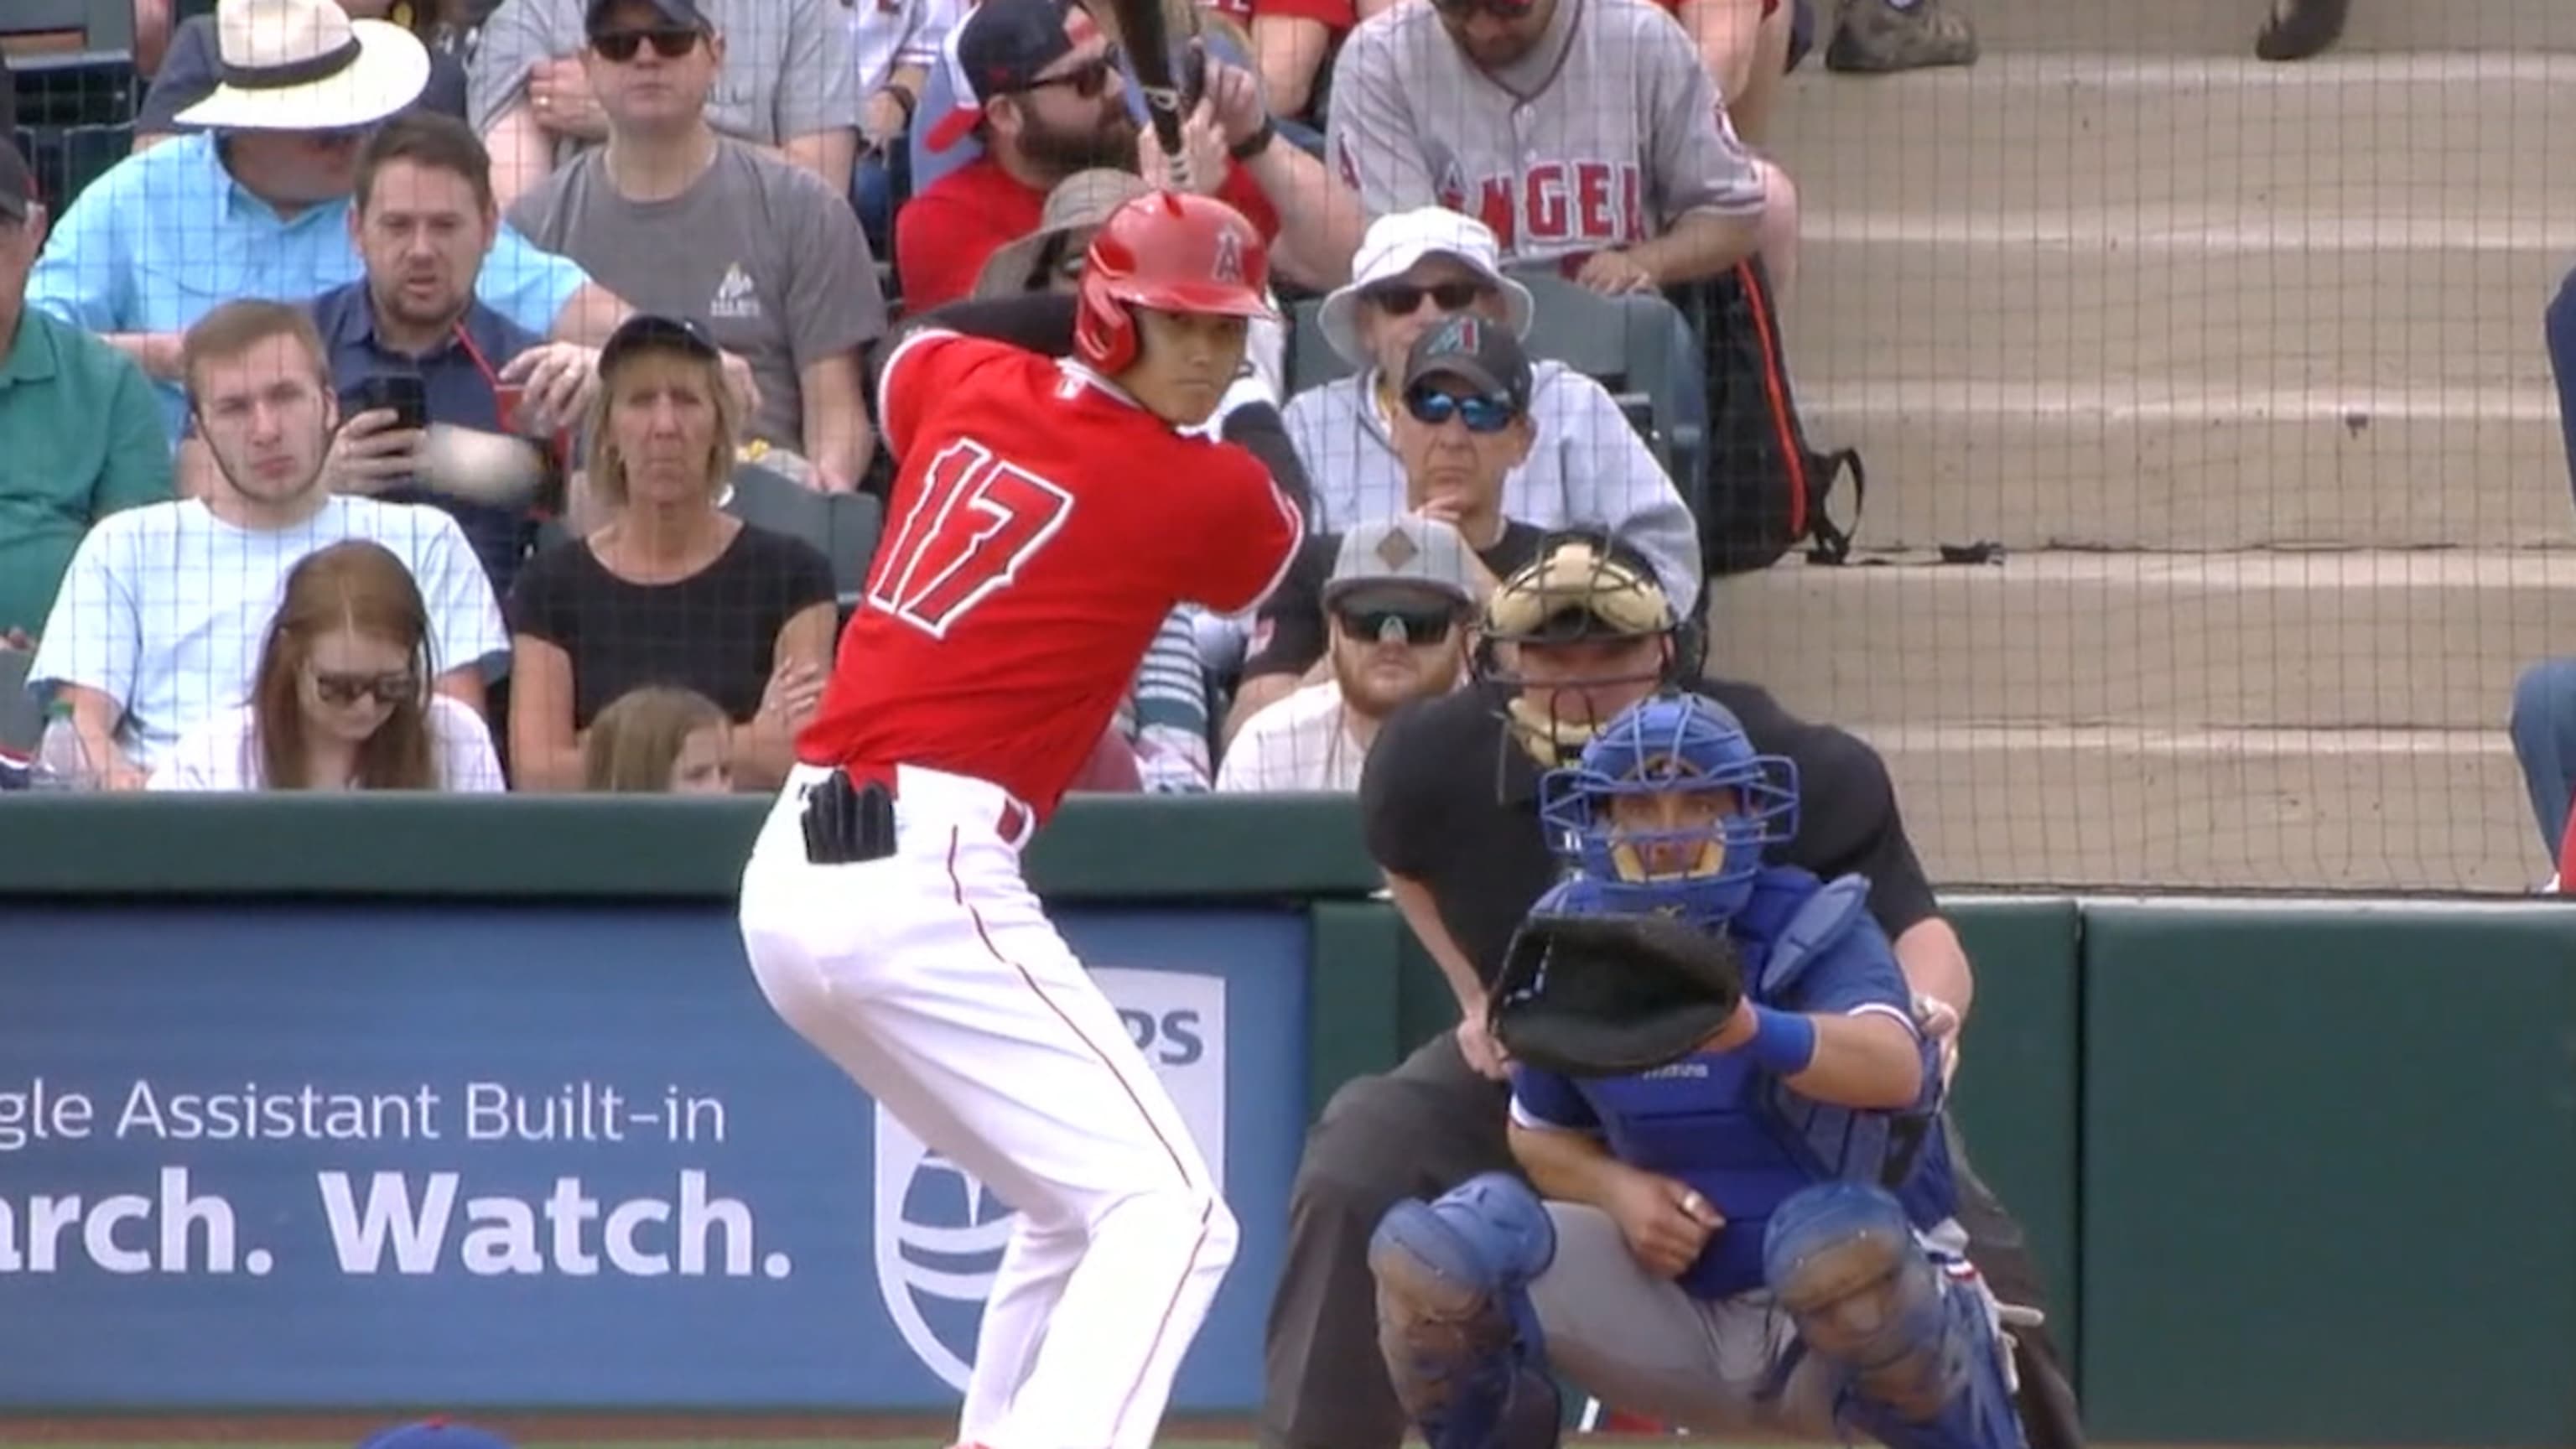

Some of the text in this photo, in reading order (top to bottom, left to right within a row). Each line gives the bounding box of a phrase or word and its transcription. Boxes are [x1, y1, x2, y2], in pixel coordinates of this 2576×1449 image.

[868, 436, 1074, 640] 17
[116, 1080, 440, 1139] Assistant
[465, 1081, 724, 1141] Built-in
[0, 1166, 791, 1278] rch. Watch.
